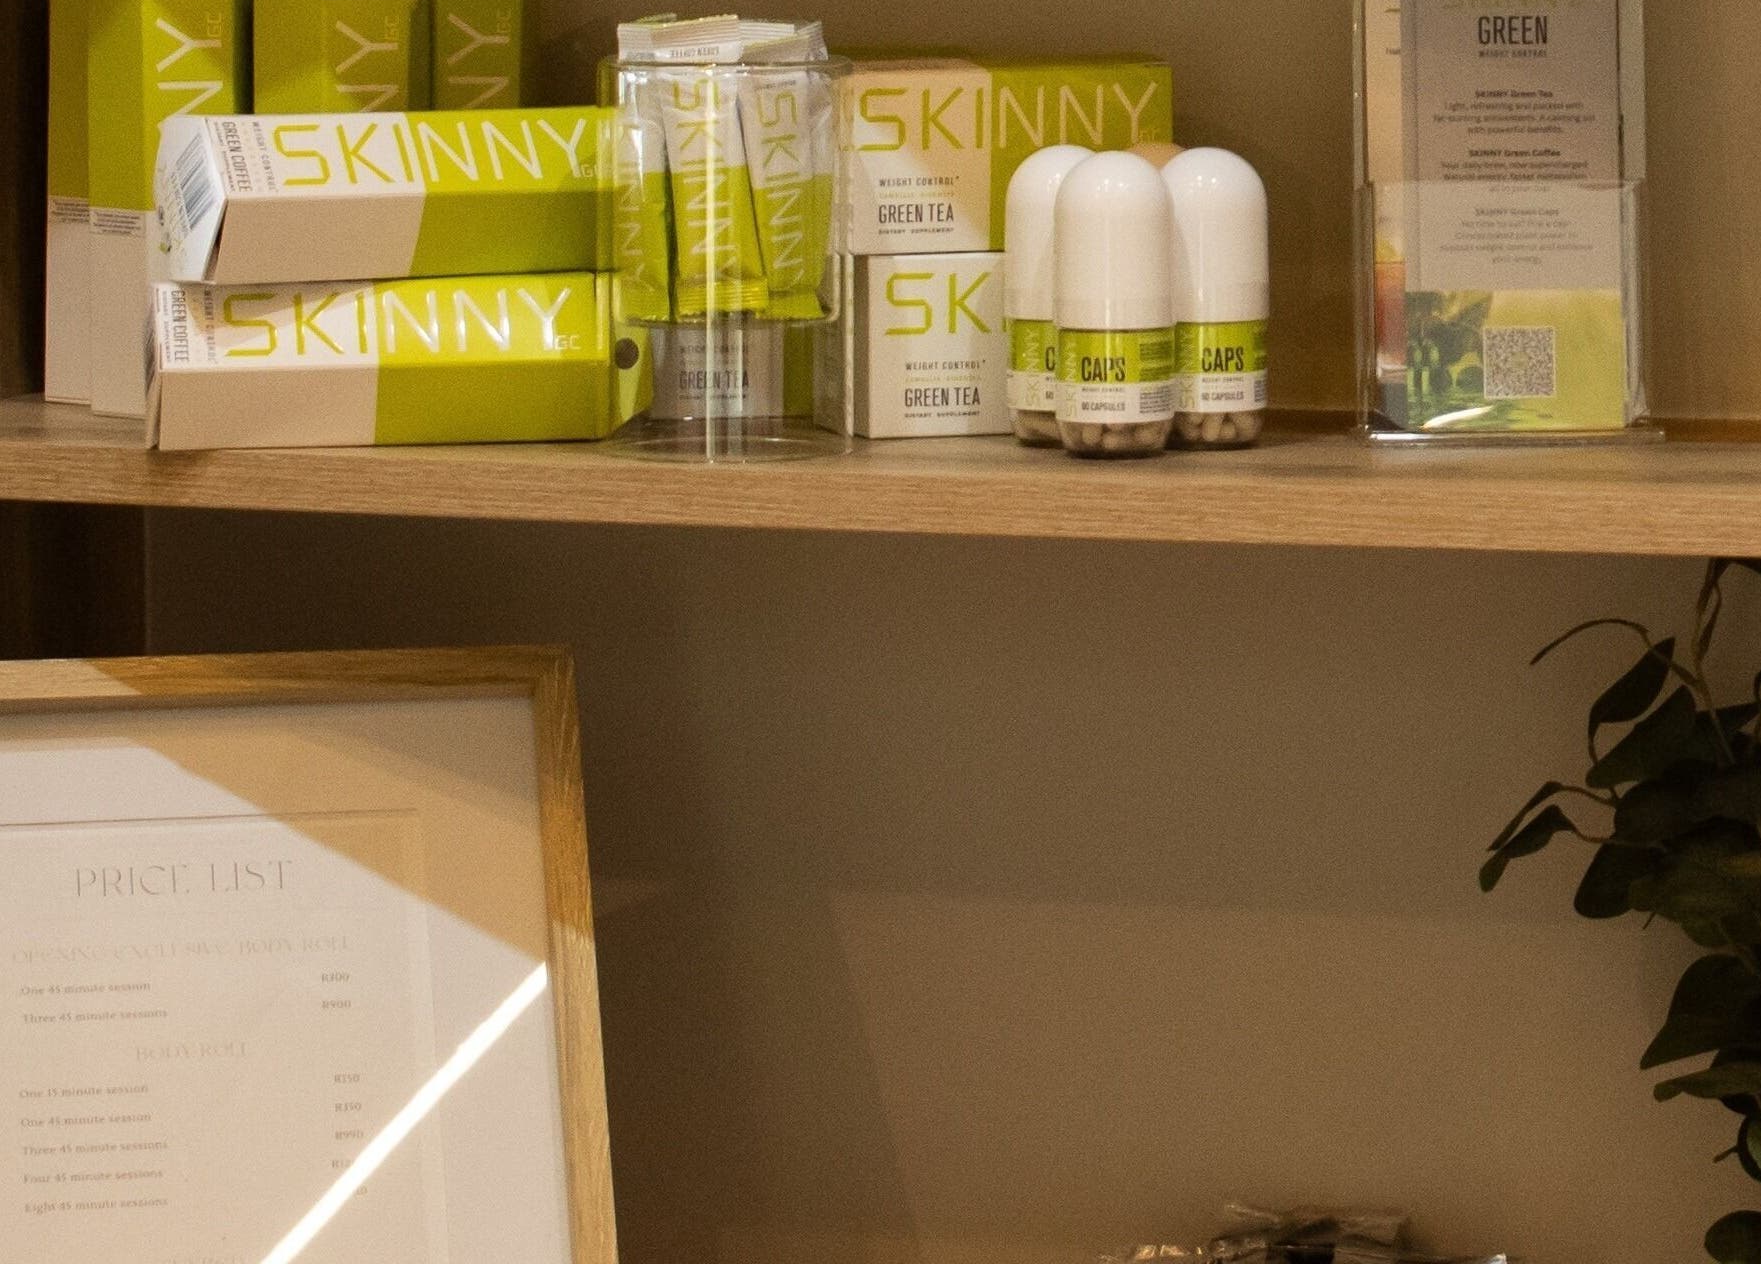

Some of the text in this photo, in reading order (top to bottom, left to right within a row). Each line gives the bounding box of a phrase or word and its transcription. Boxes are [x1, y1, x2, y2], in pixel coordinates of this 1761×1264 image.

[1478, 16, 1548, 45] GREEN
[858, 82, 1158, 151] SKINNY
[222, 122, 254, 192] GREEN COFFEE
[273, 117, 587, 187] SKINNY
[879, 177, 912, 187] WEIGHT
[878, 203, 955, 224] GREEN TEA
[171, 290, 190, 363] GREEN COFFEE
[223, 287, 572, 358] SKINNY
[905, 361, 938, 371] WEIGHT
[1081, 357, 1126, 382] CAPS
[1201, 346, 1244, 372] CAPS
[904, 386, 981, 407] GREEN TEA
[1091, 401, 1126, 411] CAPSULES
[1210, 391, 1244, 400] CAPSULES
[75, 859, 293, 897] PRICE LIST
